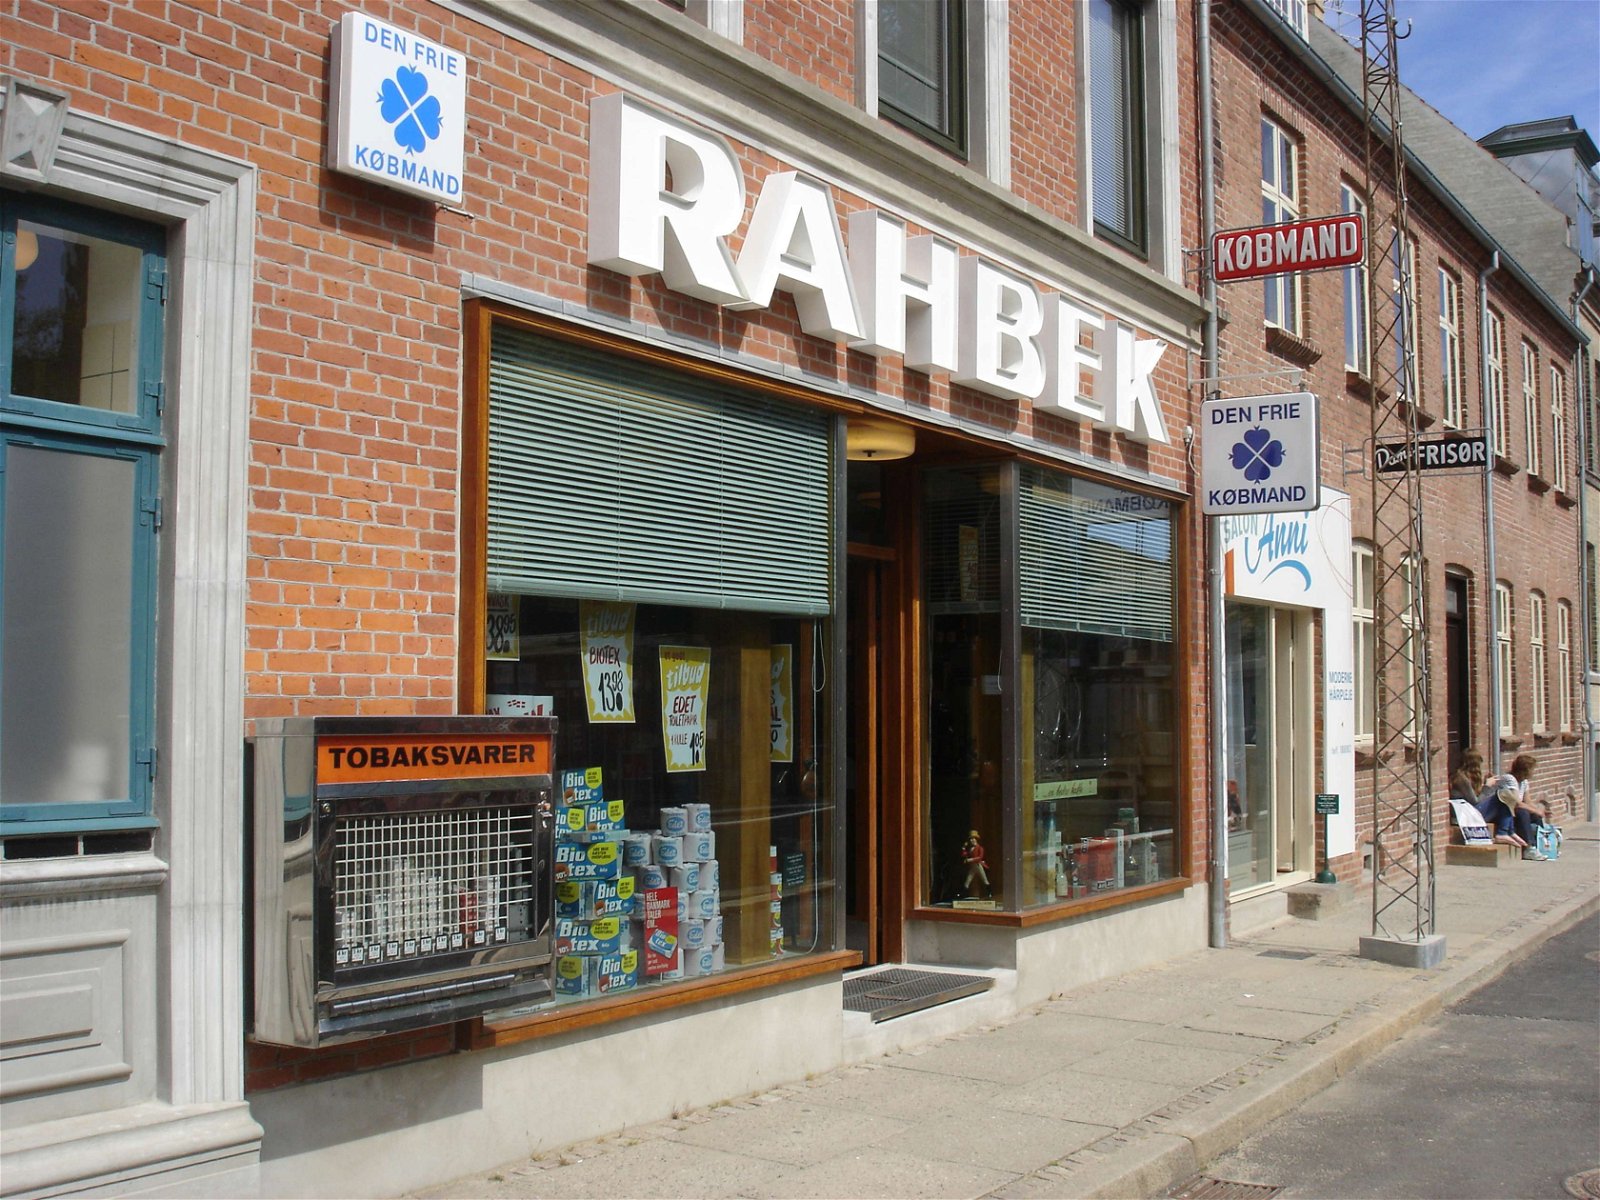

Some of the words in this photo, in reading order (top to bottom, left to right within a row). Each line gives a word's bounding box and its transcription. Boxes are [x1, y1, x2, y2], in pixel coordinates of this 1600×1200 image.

[365, 21, 406, 56] DEN
[414, 41, 458, 76] FRIE
[355, 144, 459, 195] KØBMAND
[1217, 221, 1358, 273] KØBMAND
[588, 92, 1169, 445] RAHBEK
[1211, 407, 1251, 425] DEN
[1258, 403, 1300, 421] FRIE
[1208, 485, 1306, 506] KØBMAND
[1224, 515, 1258, 544] SALON
[1245, 511, 1310, 574] Anni
[589, 645, 621, 668] BIOTEX
[666, 660, 706, 690] tilbud
[673, 695, 697, 714] EDET
[328, 743, 536, 769] TOBAKSVARER
[566, 772, 584, 787] Bio
[574, 788, 592, 800] tex
[589, 807, 607, 822] Bio
[556, 847, 586, 863] Bio
[568, 863, 597, 876] tex
[598, 883, 616, 899] Bio
[604, 899, 623, 913] tex
[560, 921, 588, 937] Bio
[571, 937, 599, 951] tex
[602, 958, 620, 975] Bio
[609, 974, 627, 987] tex
